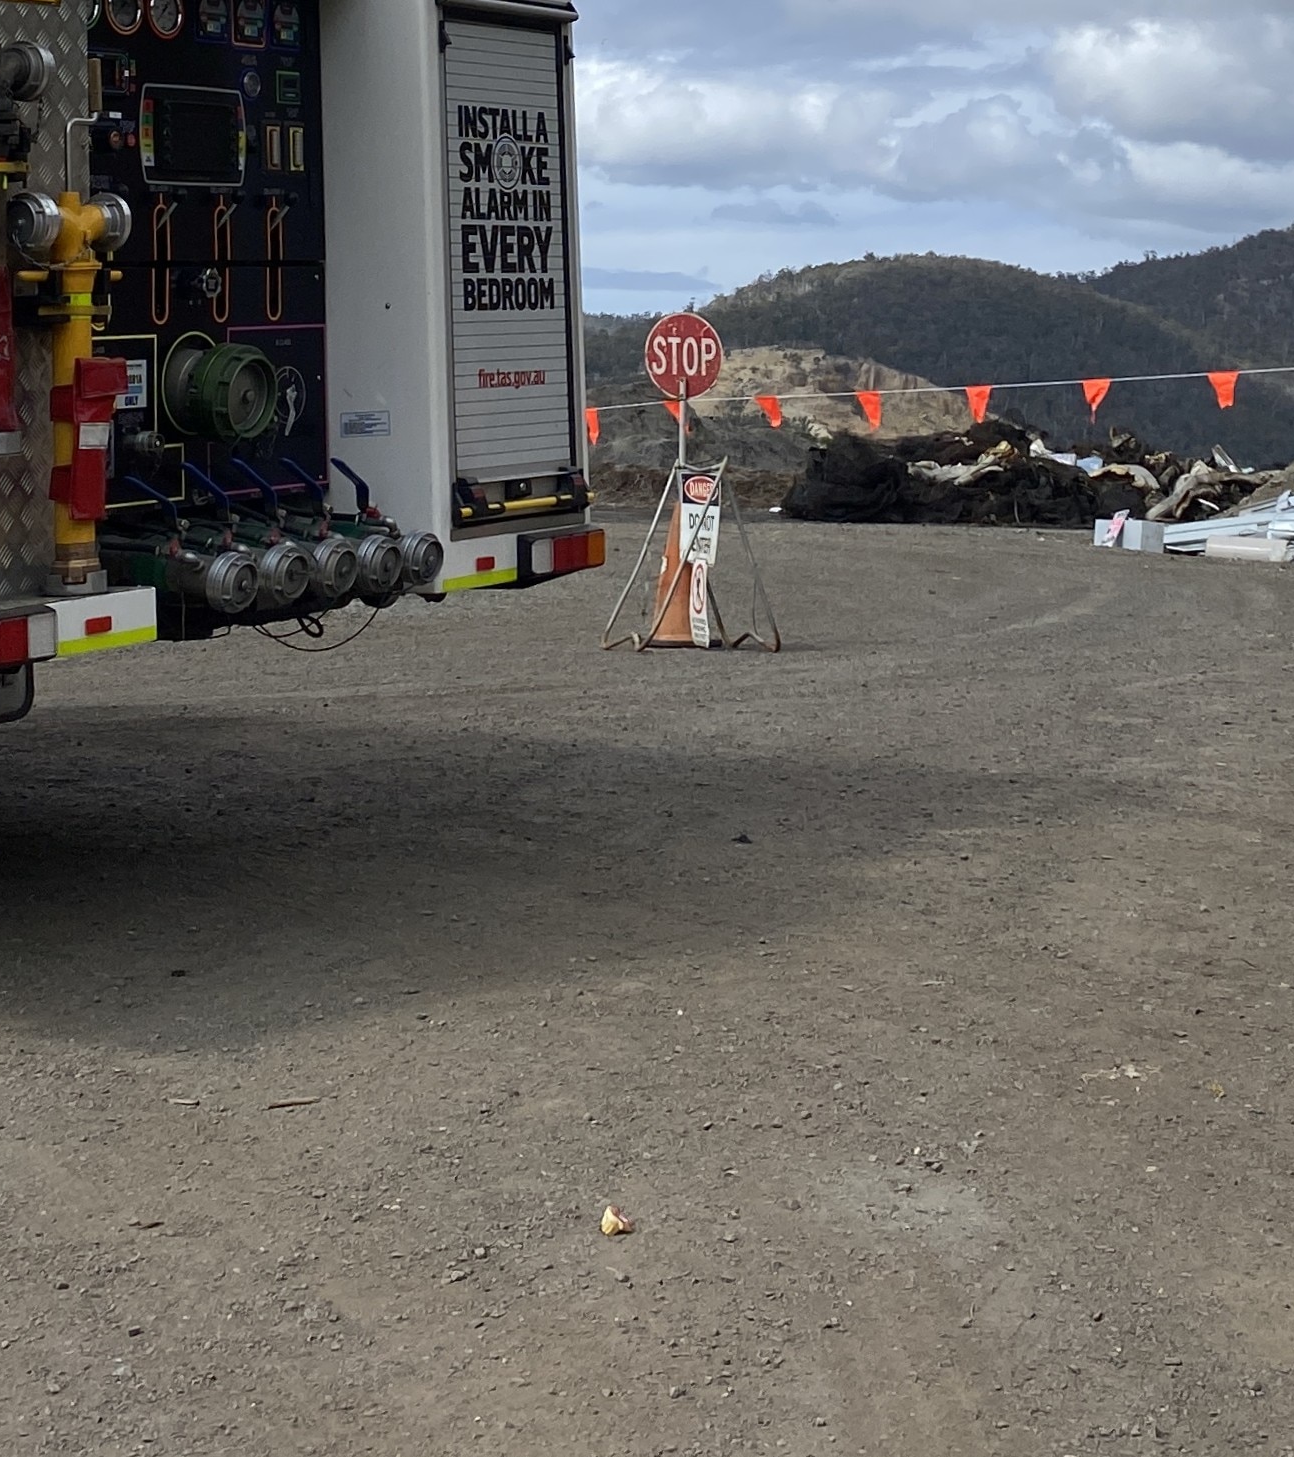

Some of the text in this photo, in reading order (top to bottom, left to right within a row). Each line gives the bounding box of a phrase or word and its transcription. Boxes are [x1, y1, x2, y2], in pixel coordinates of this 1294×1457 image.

[458, 105, 548, 143] INSTALL A
[459, 135, 550, 189] SMOKE
[461, 187, 552, 222] ALARM IN
[461, 224, 553, 274] EVERY
[463, 277, 555, 311] BEDROOM
[650, 335, 717, 377] STOP
[478, 368, 546, 390] fire.tas.gov.au
